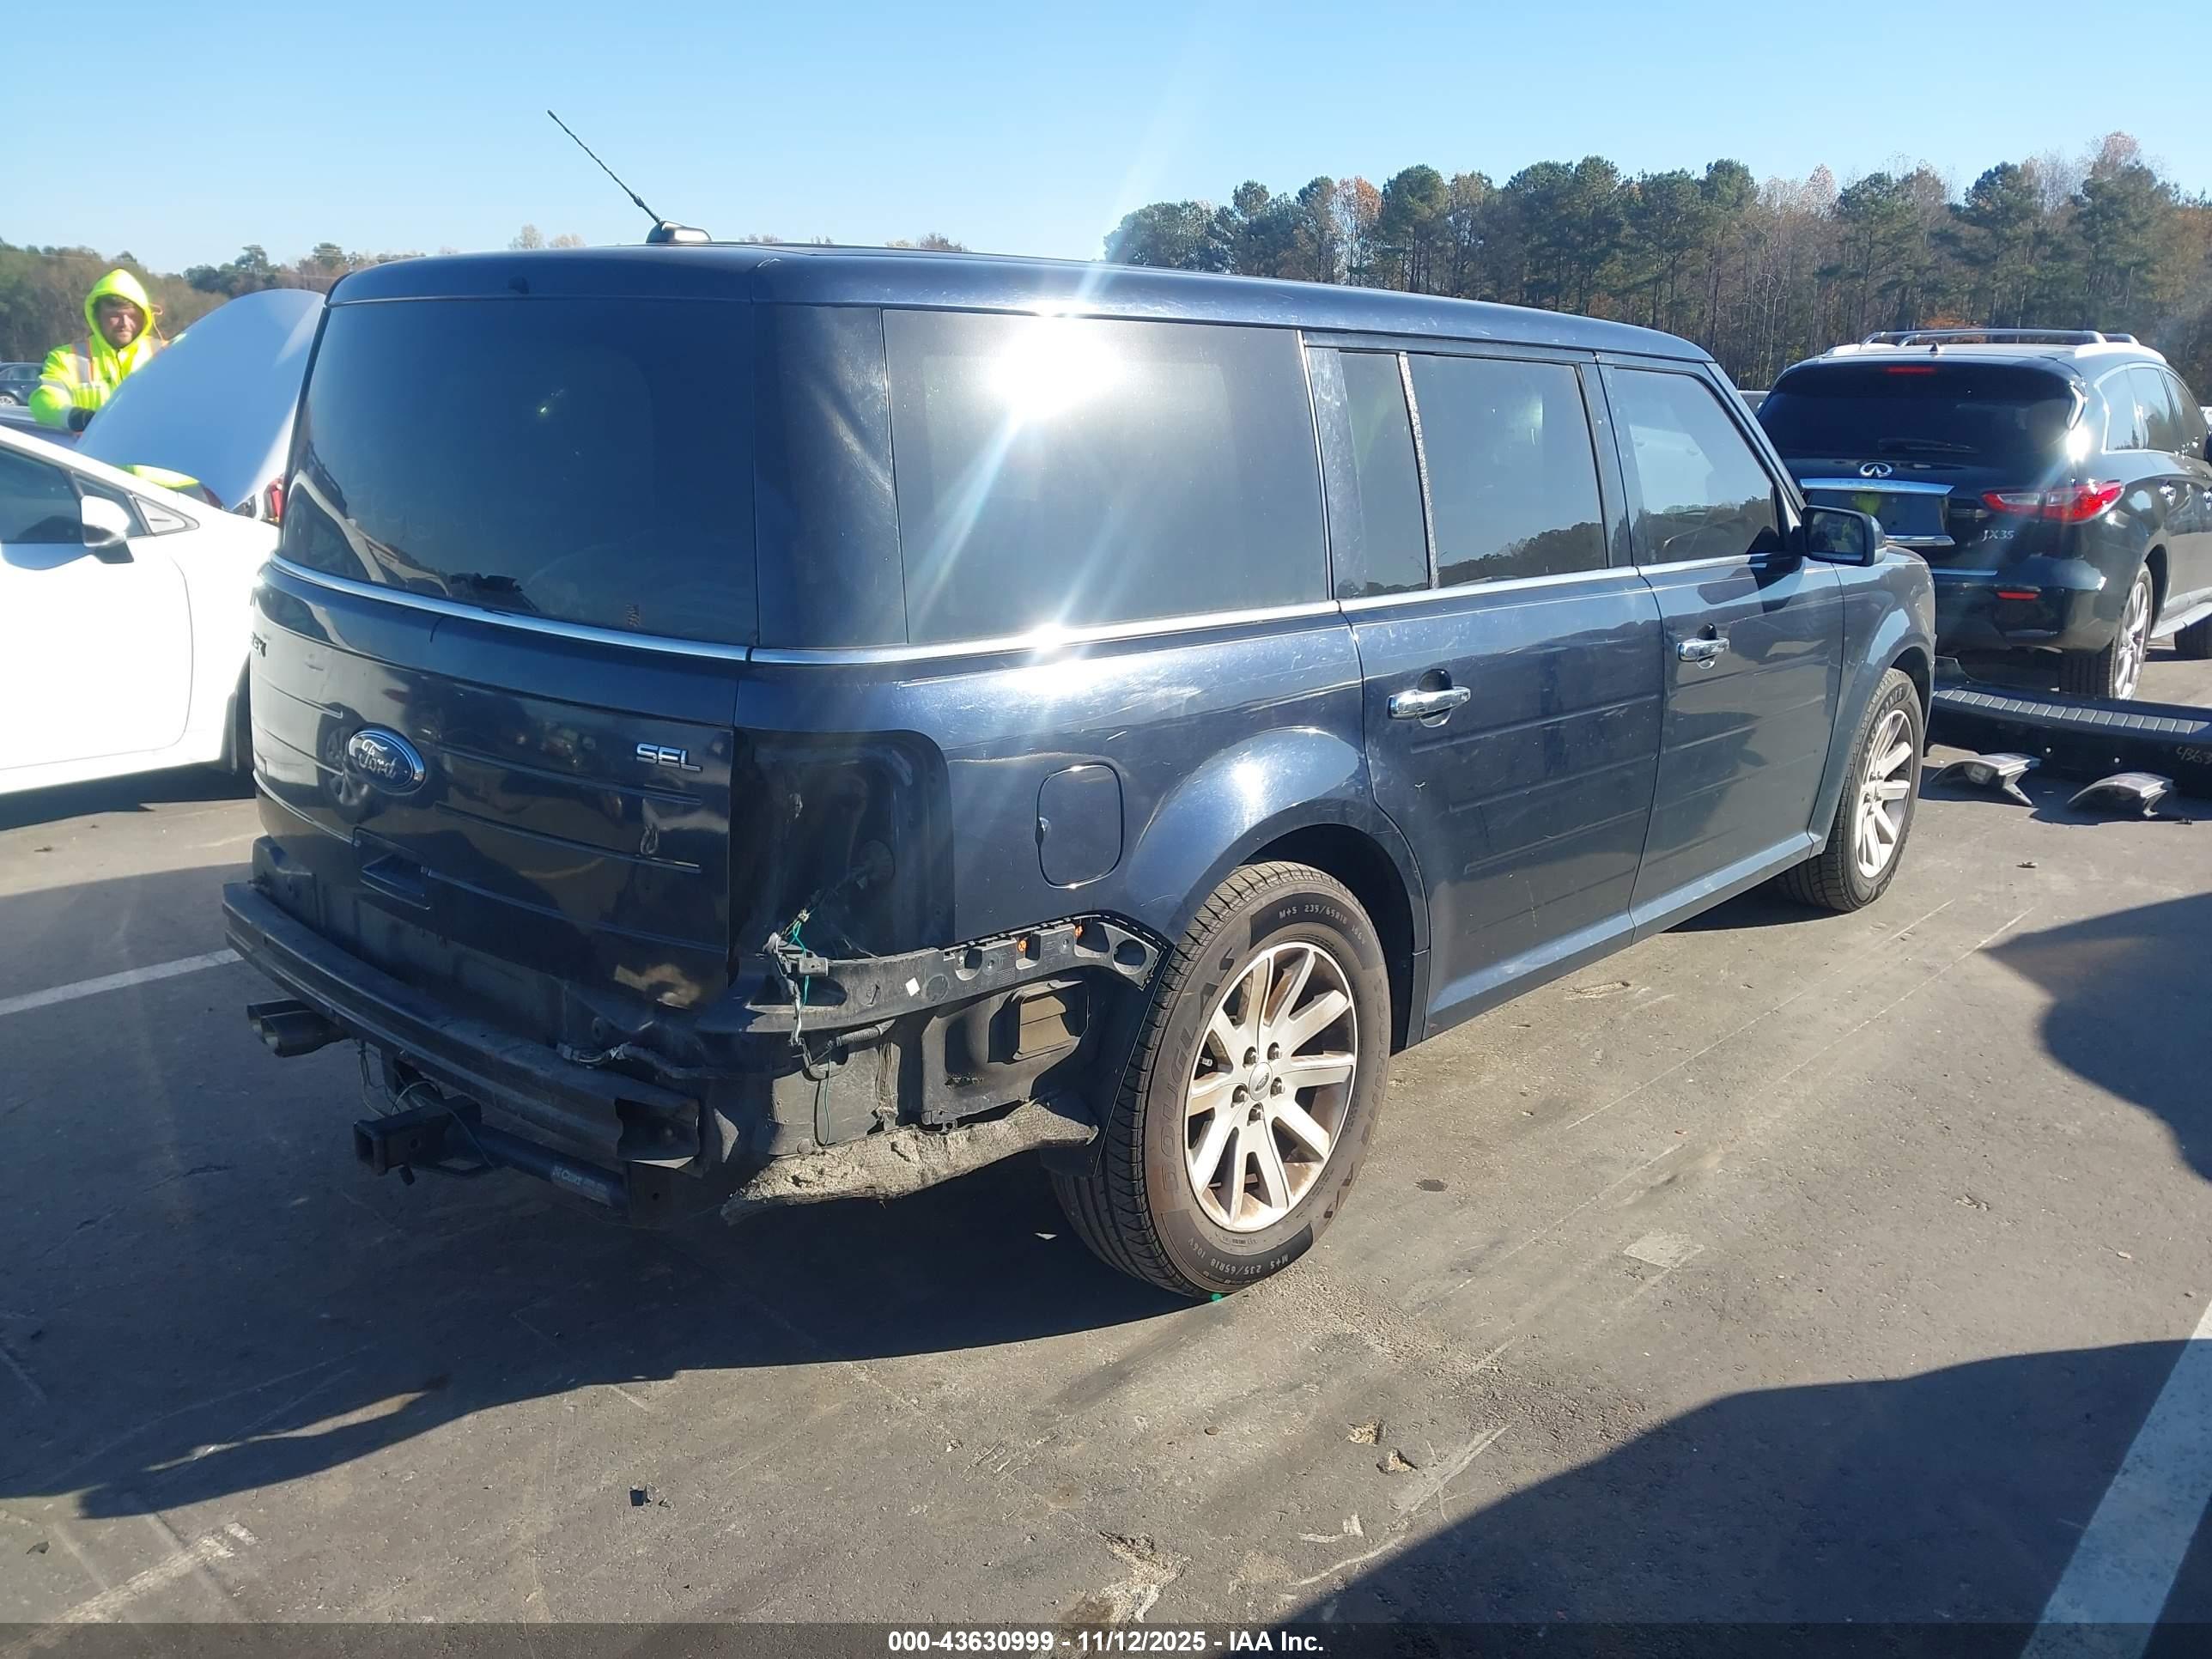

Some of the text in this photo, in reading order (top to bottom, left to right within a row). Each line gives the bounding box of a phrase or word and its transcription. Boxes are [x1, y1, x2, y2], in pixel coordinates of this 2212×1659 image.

[1982, 529, 2015, 542] JX35
[358, 738, 398, 780] Ford
[635, 742, 703, 773] SEL
[1279, 906, 1297, 920] M+S
[1304, 904, 1347, 925] 235/65R18
[1161, 946, 1235, 1191] DOUGLAS
[1210, 1257, 1262, 1276] 235/65R18
[1270, 1254, 1289, 1270] M+S
